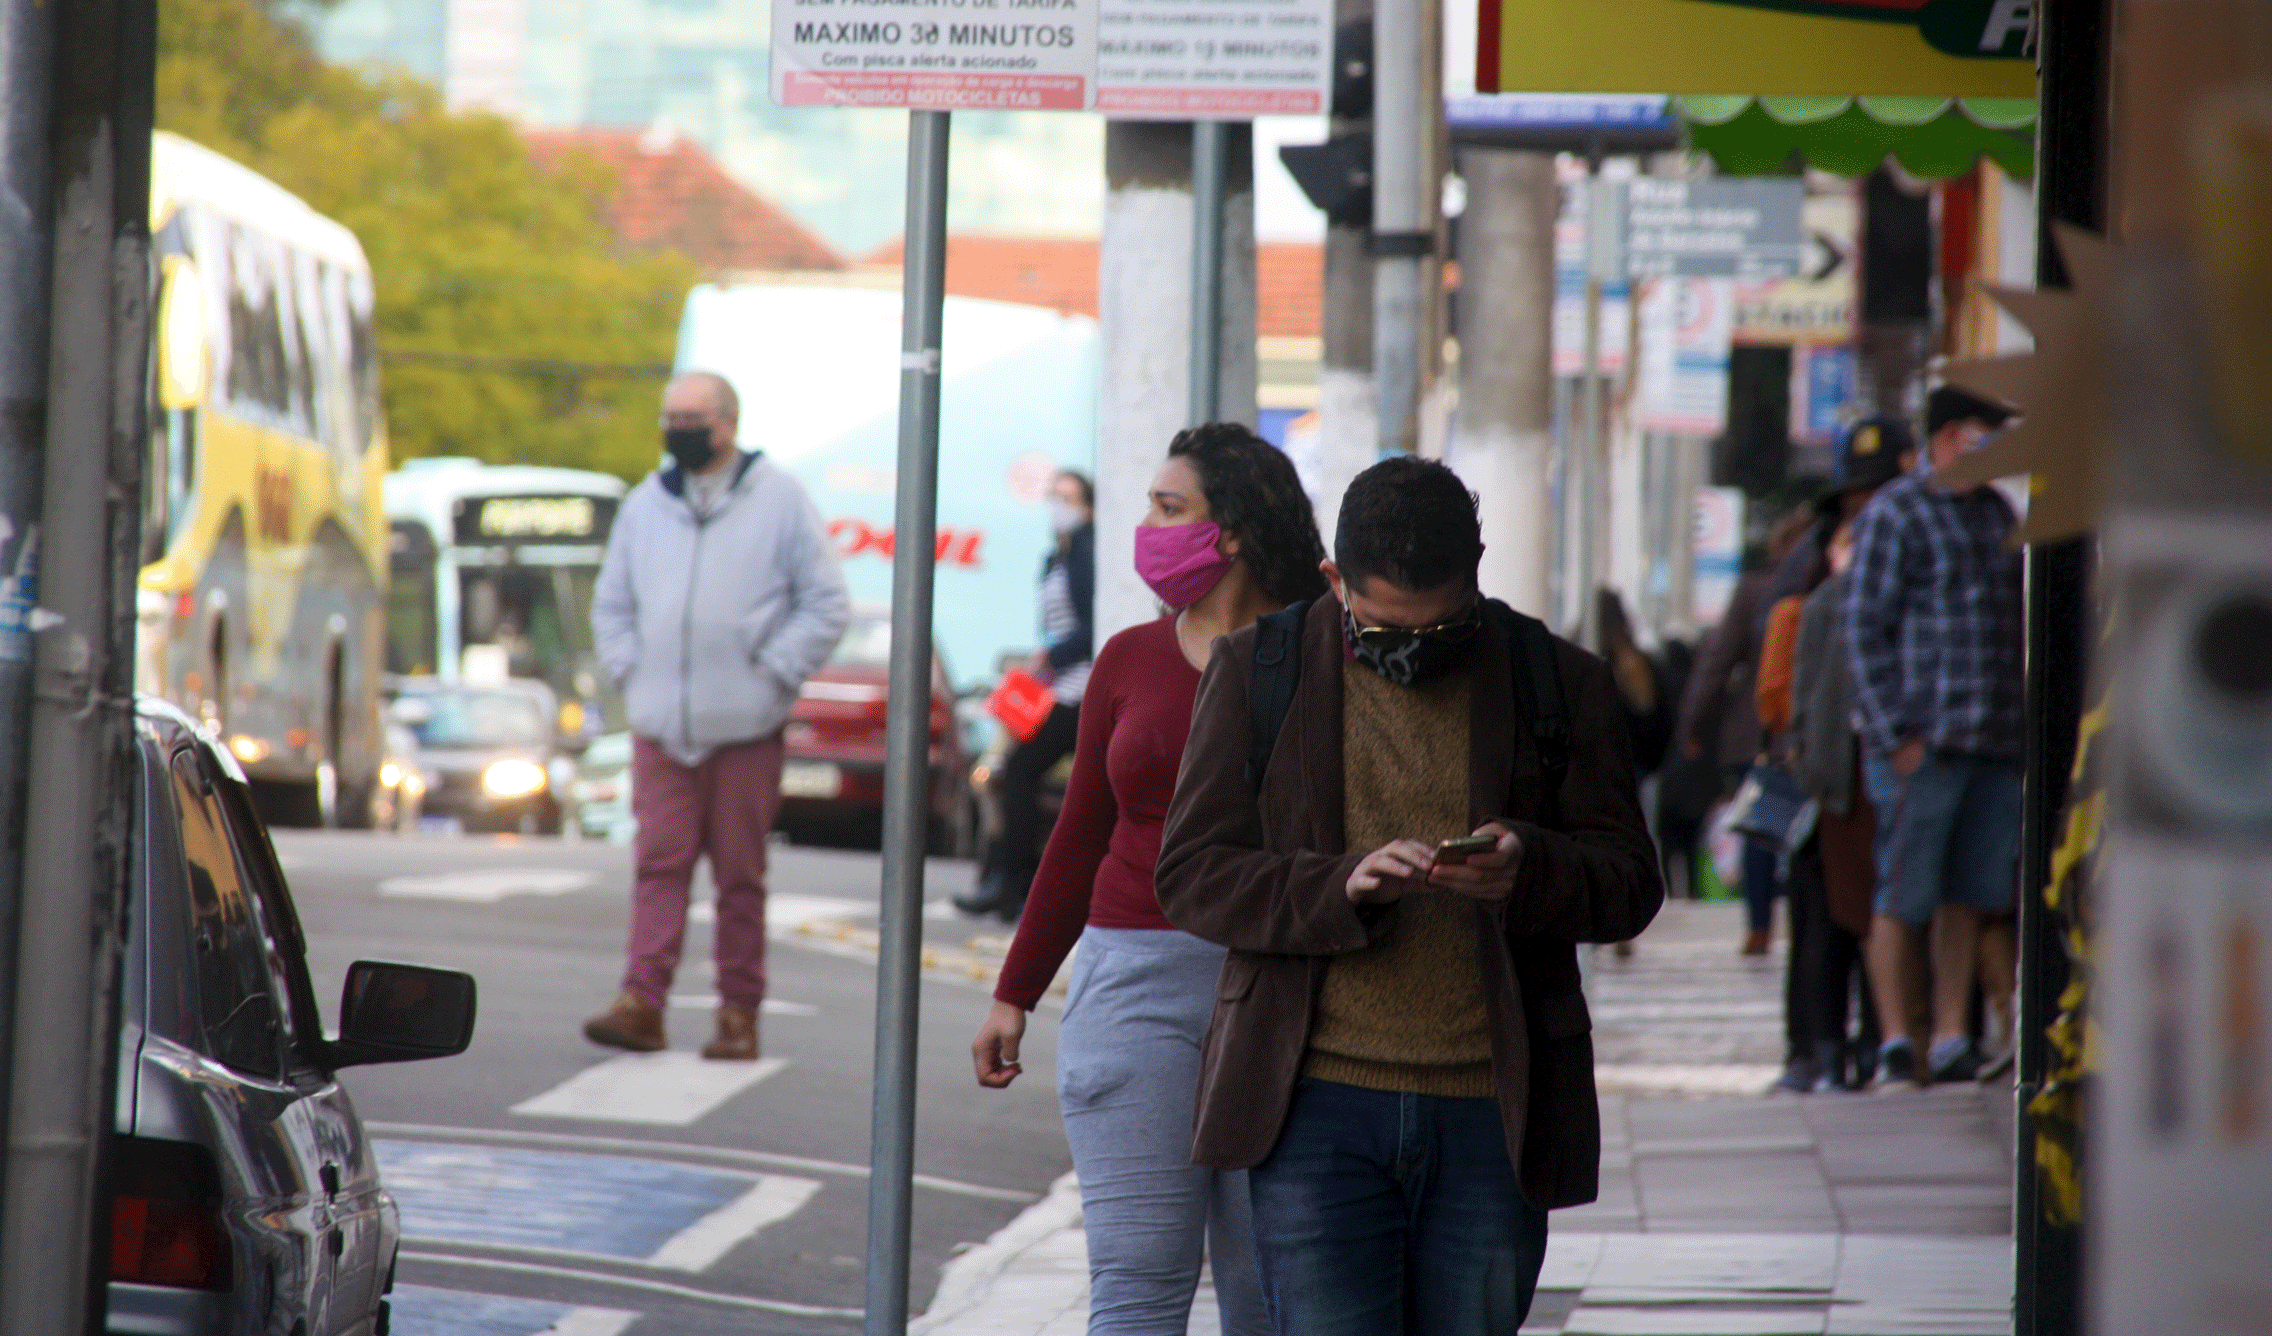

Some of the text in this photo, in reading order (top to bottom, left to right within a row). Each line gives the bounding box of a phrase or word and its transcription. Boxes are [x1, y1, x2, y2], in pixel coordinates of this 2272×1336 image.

[795, 21, 902, 44] MAXIMO
[949, 23, 1075, 47] MINUTOS
[822, 51, 1038, 69] Com pisca alerta acionado
[824, 88, 1042, 107] PROIBIDO MOTOCICLETAS
